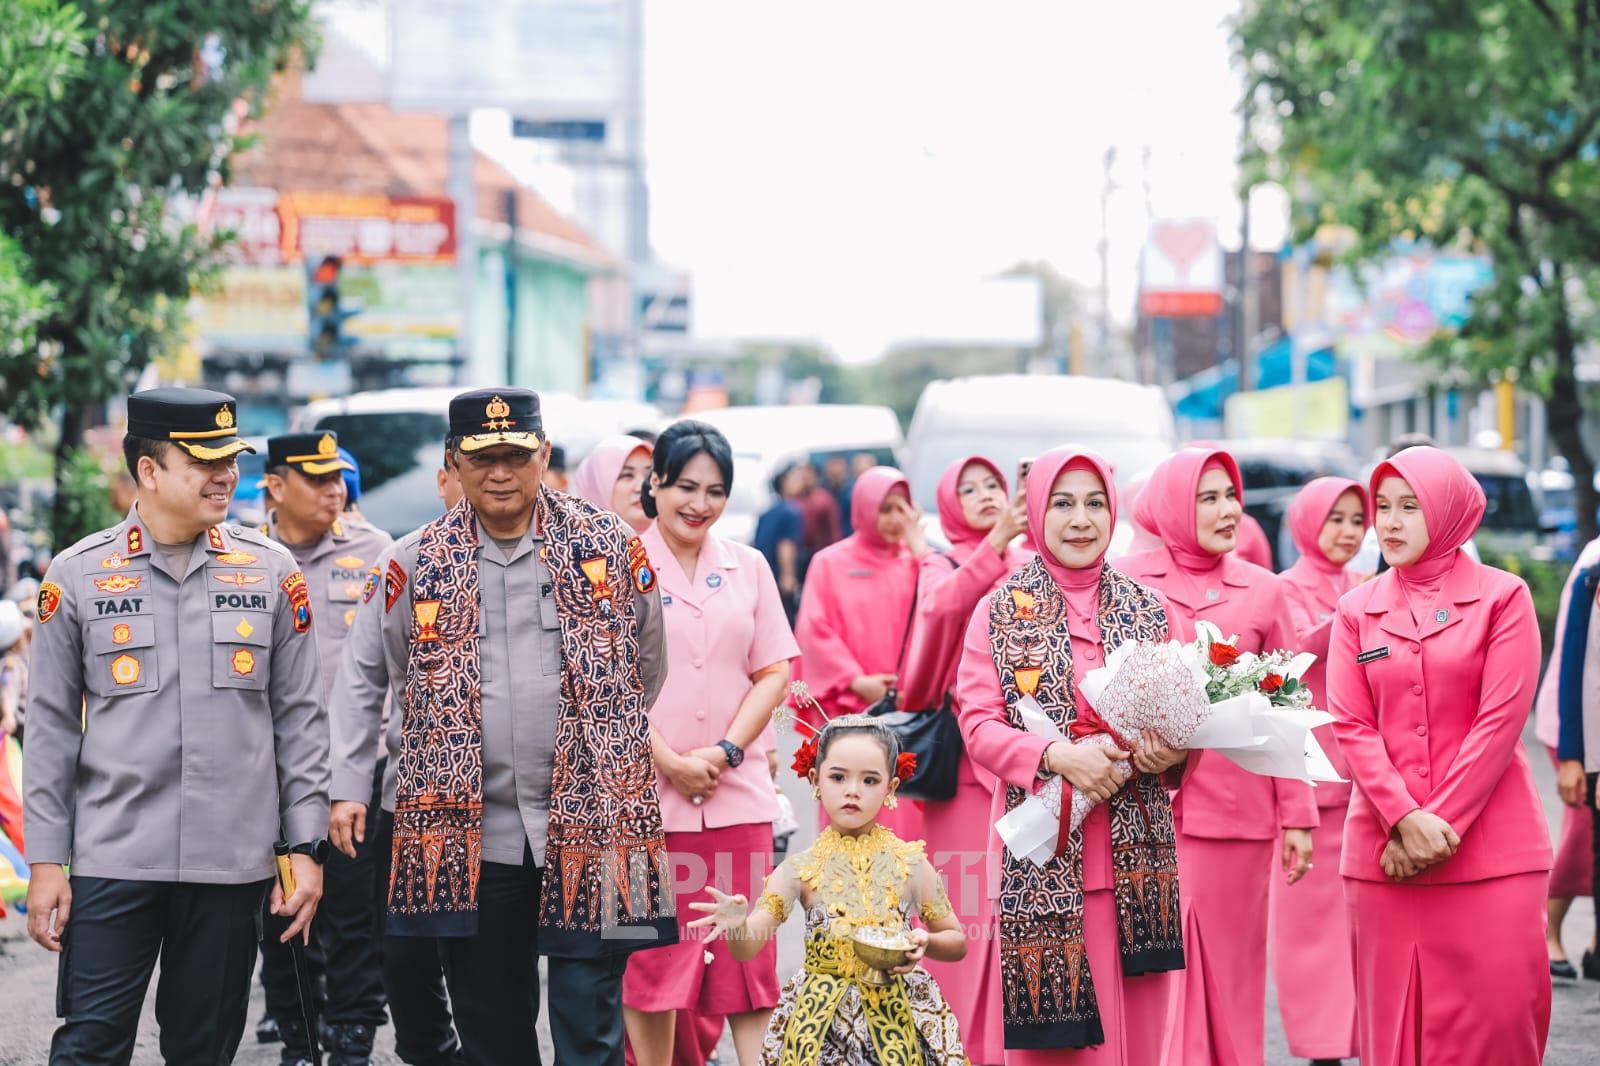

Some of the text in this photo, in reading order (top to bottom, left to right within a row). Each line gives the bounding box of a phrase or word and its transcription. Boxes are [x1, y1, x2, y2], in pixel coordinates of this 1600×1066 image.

[331, 569, 367, 580] POLR
[95, 599, 143, 615] TAAT
[215, 594, 267, 609] POLRI
